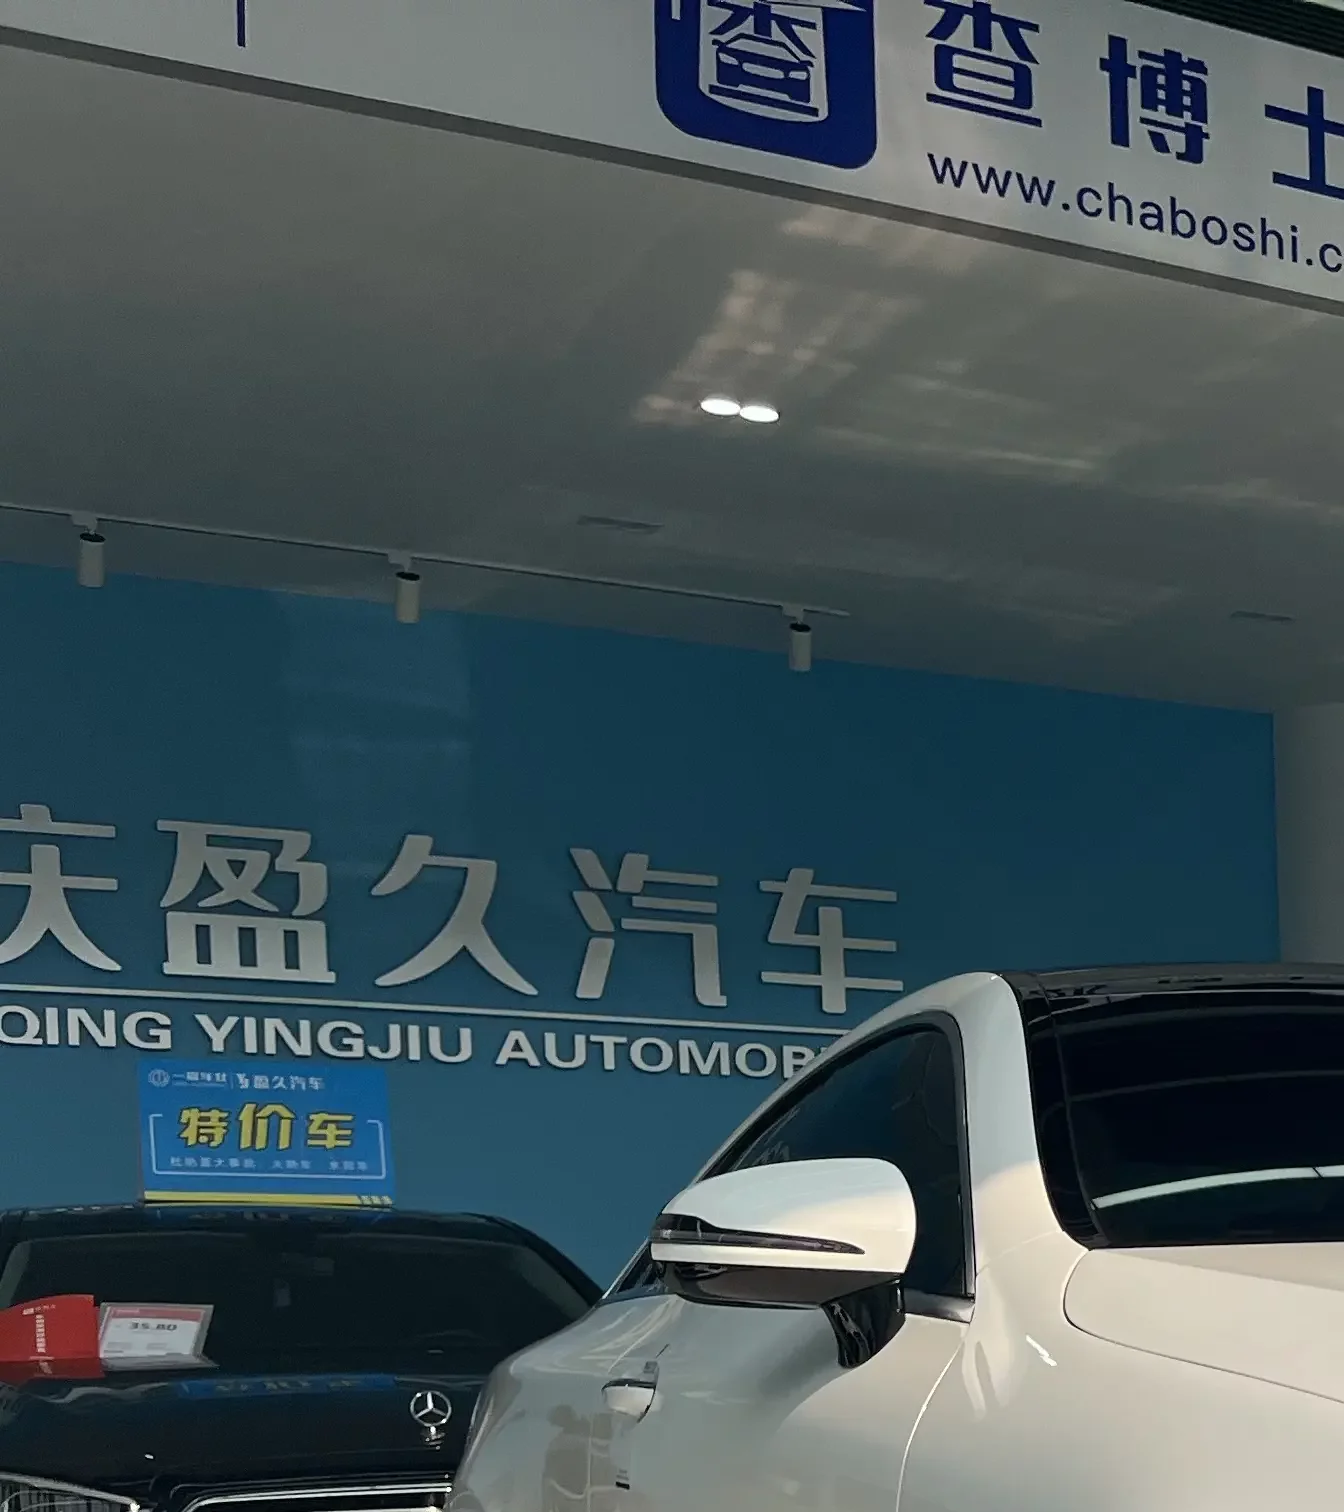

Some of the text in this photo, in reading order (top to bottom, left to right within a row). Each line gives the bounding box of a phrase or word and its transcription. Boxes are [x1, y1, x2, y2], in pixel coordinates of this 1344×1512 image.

[0, 804, 905, 1015] 庆盈久汽车
[0, 1004, 828, 1080] QING YINGJIU AUTOMOB
[178, 1101, 356, 1151] 特价车
